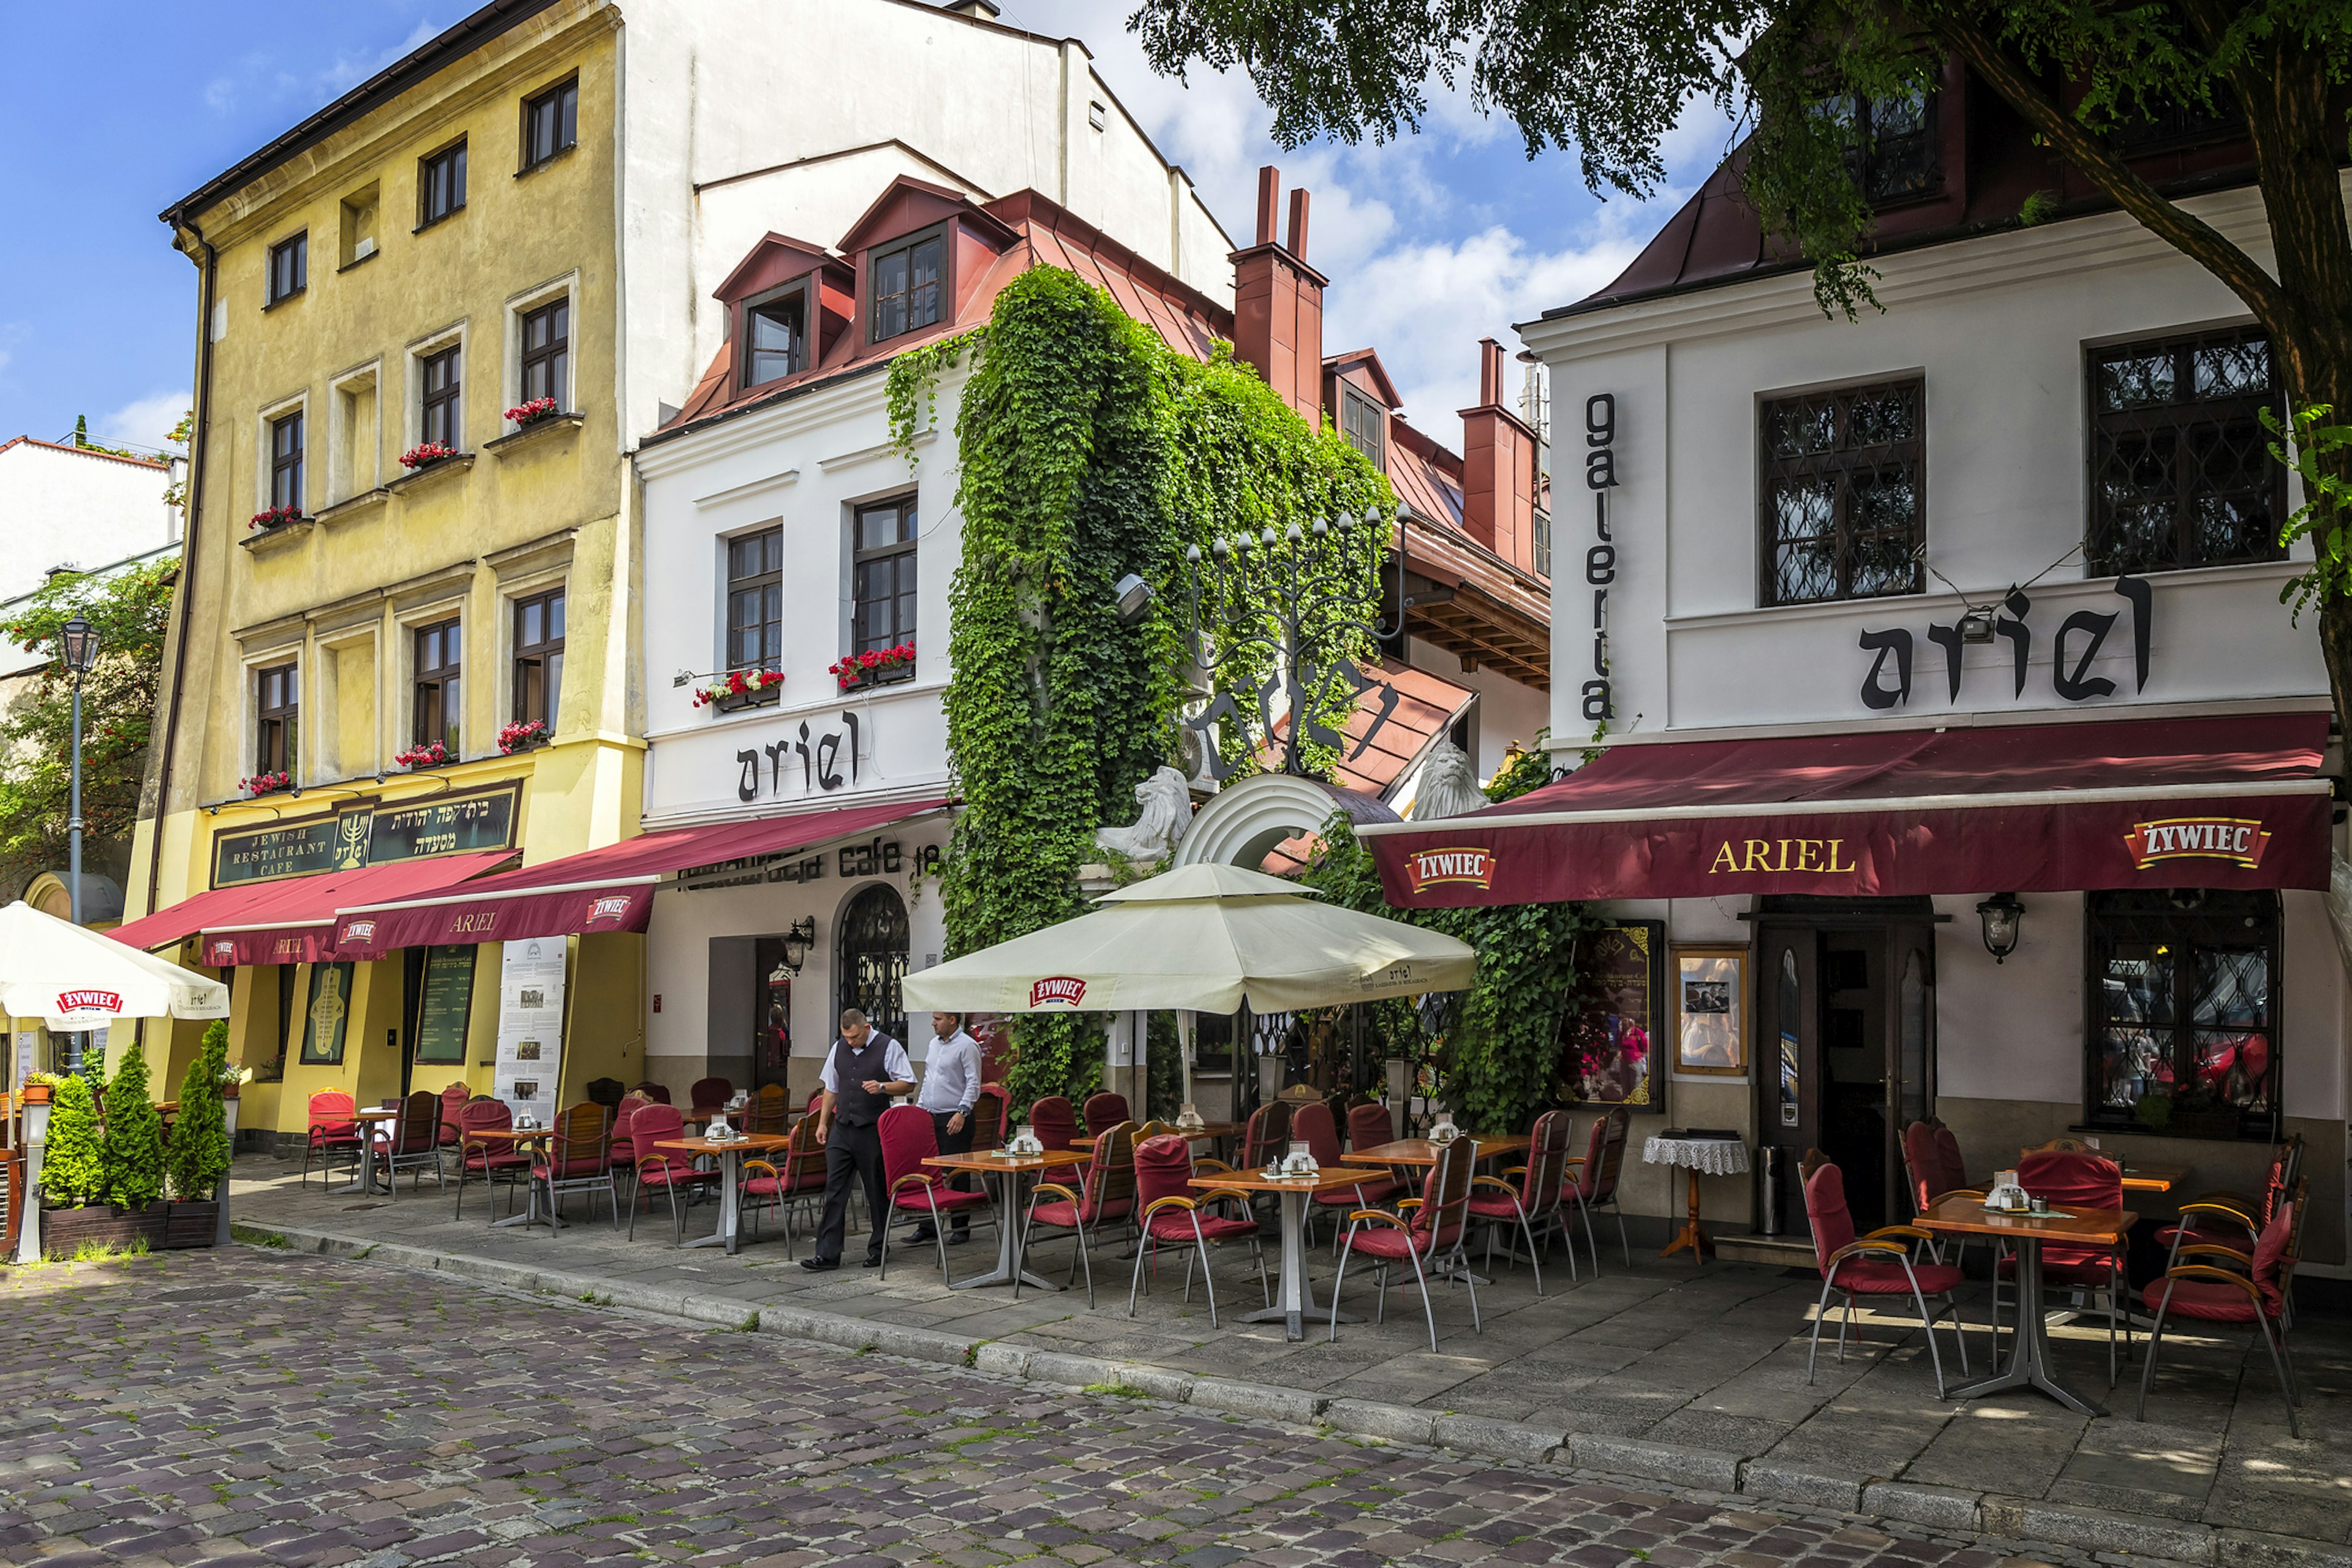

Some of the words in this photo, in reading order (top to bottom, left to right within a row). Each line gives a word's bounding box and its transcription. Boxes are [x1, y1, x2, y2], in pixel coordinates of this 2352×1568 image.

[1581, 393, 1620, 720] galeria
[1858, 572, 2152, 710] ariel
[736, 709, 858, 802] ariel
[252, 829, 306, 848] JEWISH
[413, 832, 456, 854] מסעדה
[2144, 824, 2252, 854] ŻYWIEC
[232, 841, 326, 865] RESTAURANT
[839, 836, 902, 877] cafe
[1708, 839, 1856, 873] ARIEL
[260, 861, 293, 876] CAFE
[1417, 853, 1485, 879] ŻYWIEC
[450, 912, 497, 933] ARIEL
[64, 990, 116, 1007] ŻYWIEC
[1037, 979, 1082, 999] ŻYWIEC
